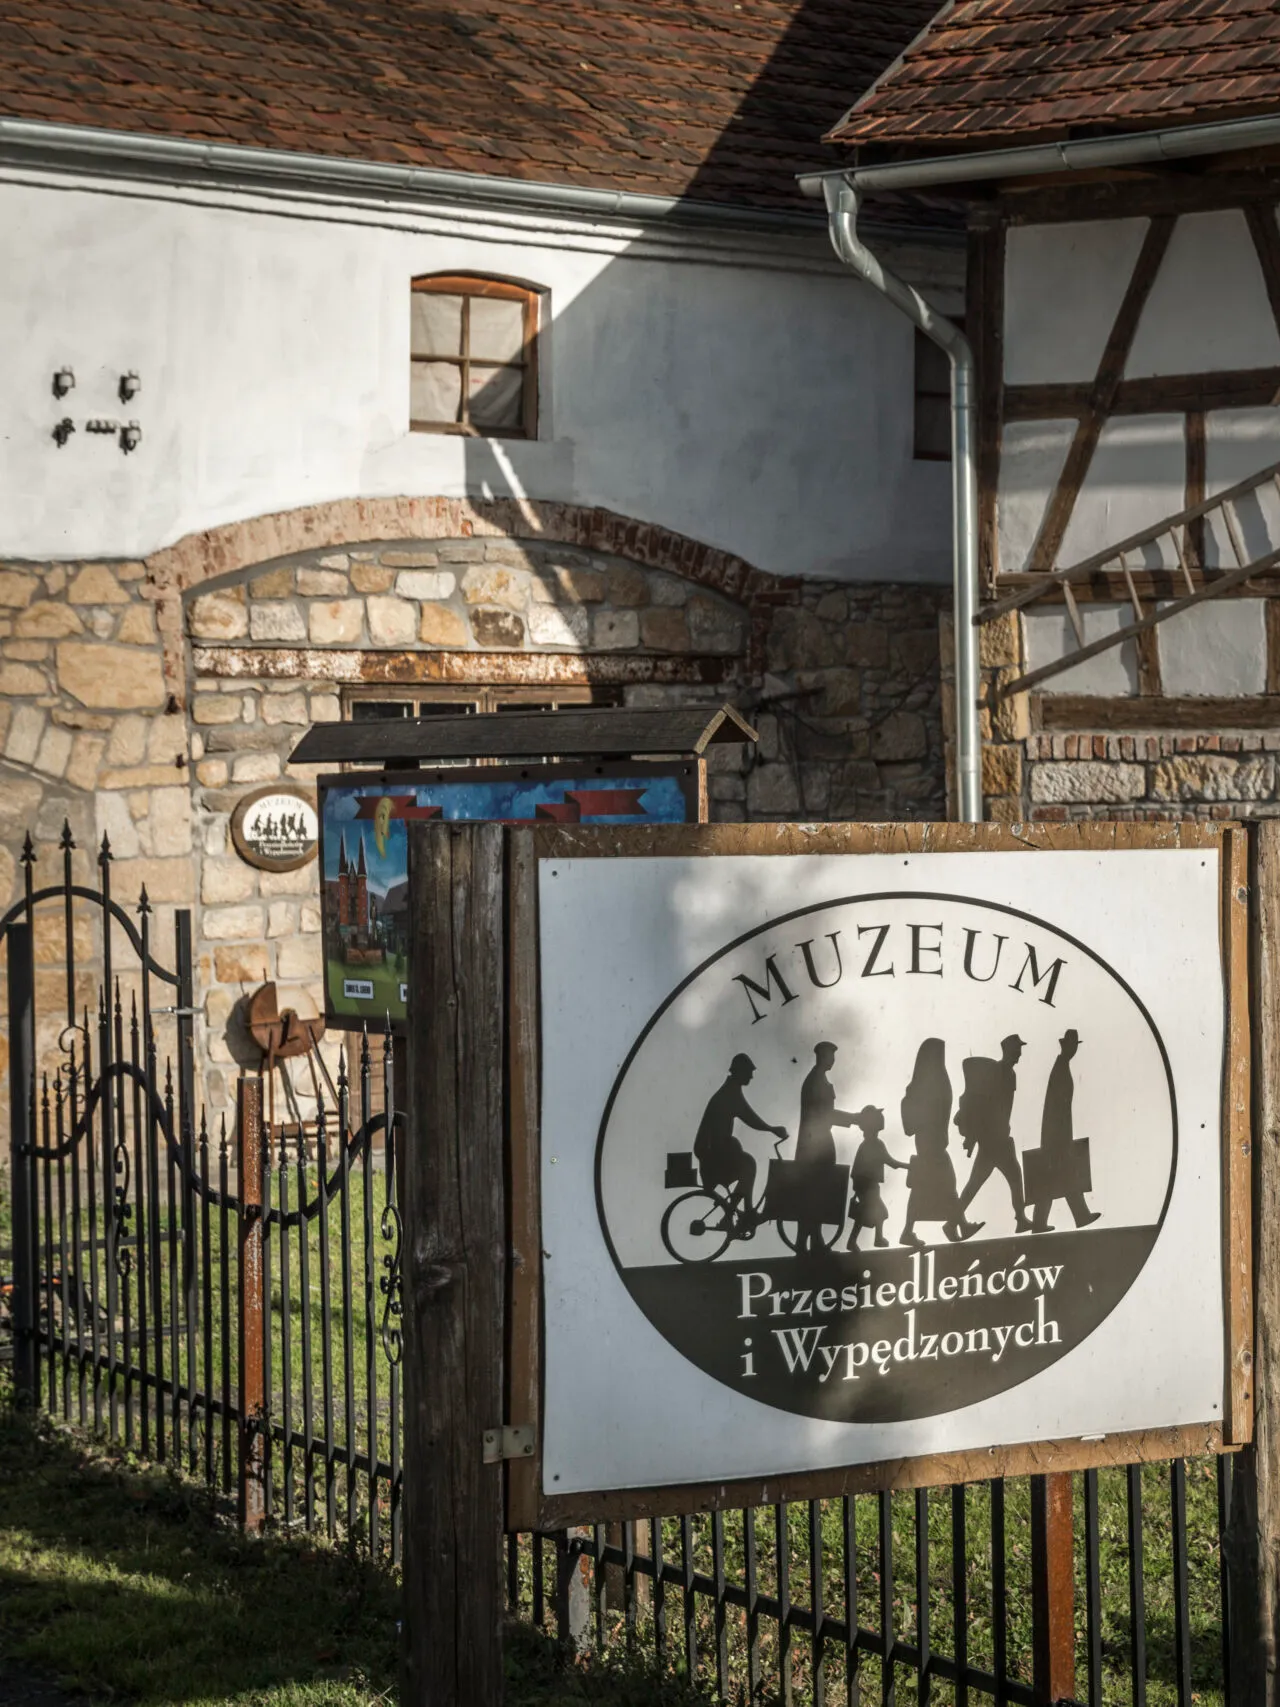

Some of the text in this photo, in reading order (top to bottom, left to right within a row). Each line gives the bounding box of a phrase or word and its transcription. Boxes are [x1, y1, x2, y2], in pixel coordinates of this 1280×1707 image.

[732, 922, 1068, 1025] MUZEUM
[736, 1250, 1064, 1318] Przesiedleńców
[741, 1296, 1063, 1383] i Wypędzonych
